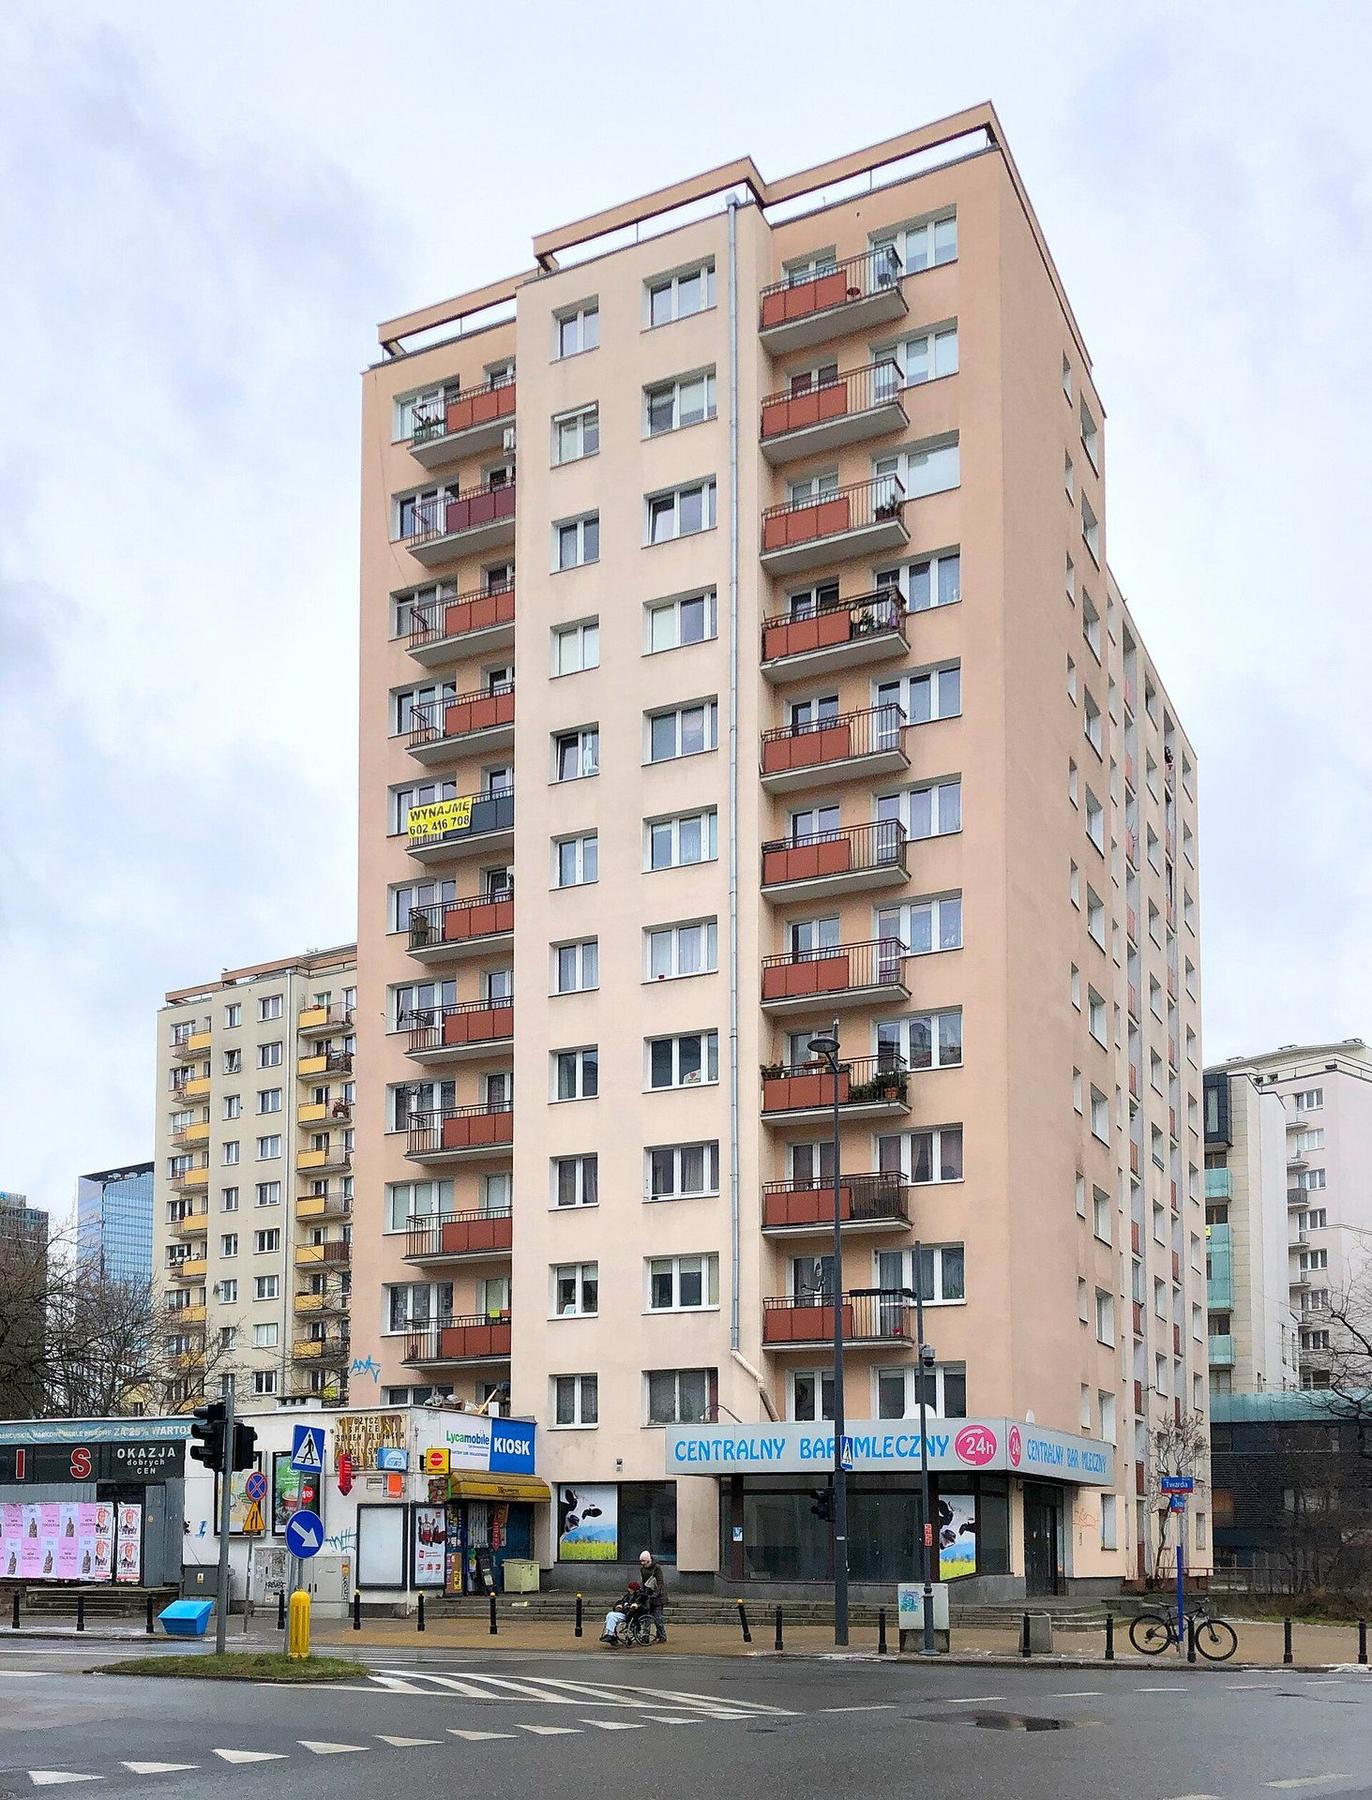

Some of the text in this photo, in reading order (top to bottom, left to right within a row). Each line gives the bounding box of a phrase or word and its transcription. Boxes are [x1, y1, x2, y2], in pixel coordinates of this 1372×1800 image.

[410, 801, 470, 822] WYNAJMĘ
[409, 814, 470, 836] 602 416 708
[446, 1431, 490, 1446] Lycamobile
[493, 1437, 531, 1456] KIOSK
[675, 1438, 786, 1461] CENTRALNY
[854, 1434, 950, 1458] MLECZNY
[966, 1436, 994, 1455] 24h
[116, 1447, 176, 1459] OKAZJA
[127, 1459, 165, 1467] dobrych
[136, 1467, 156, 1475] CEN
